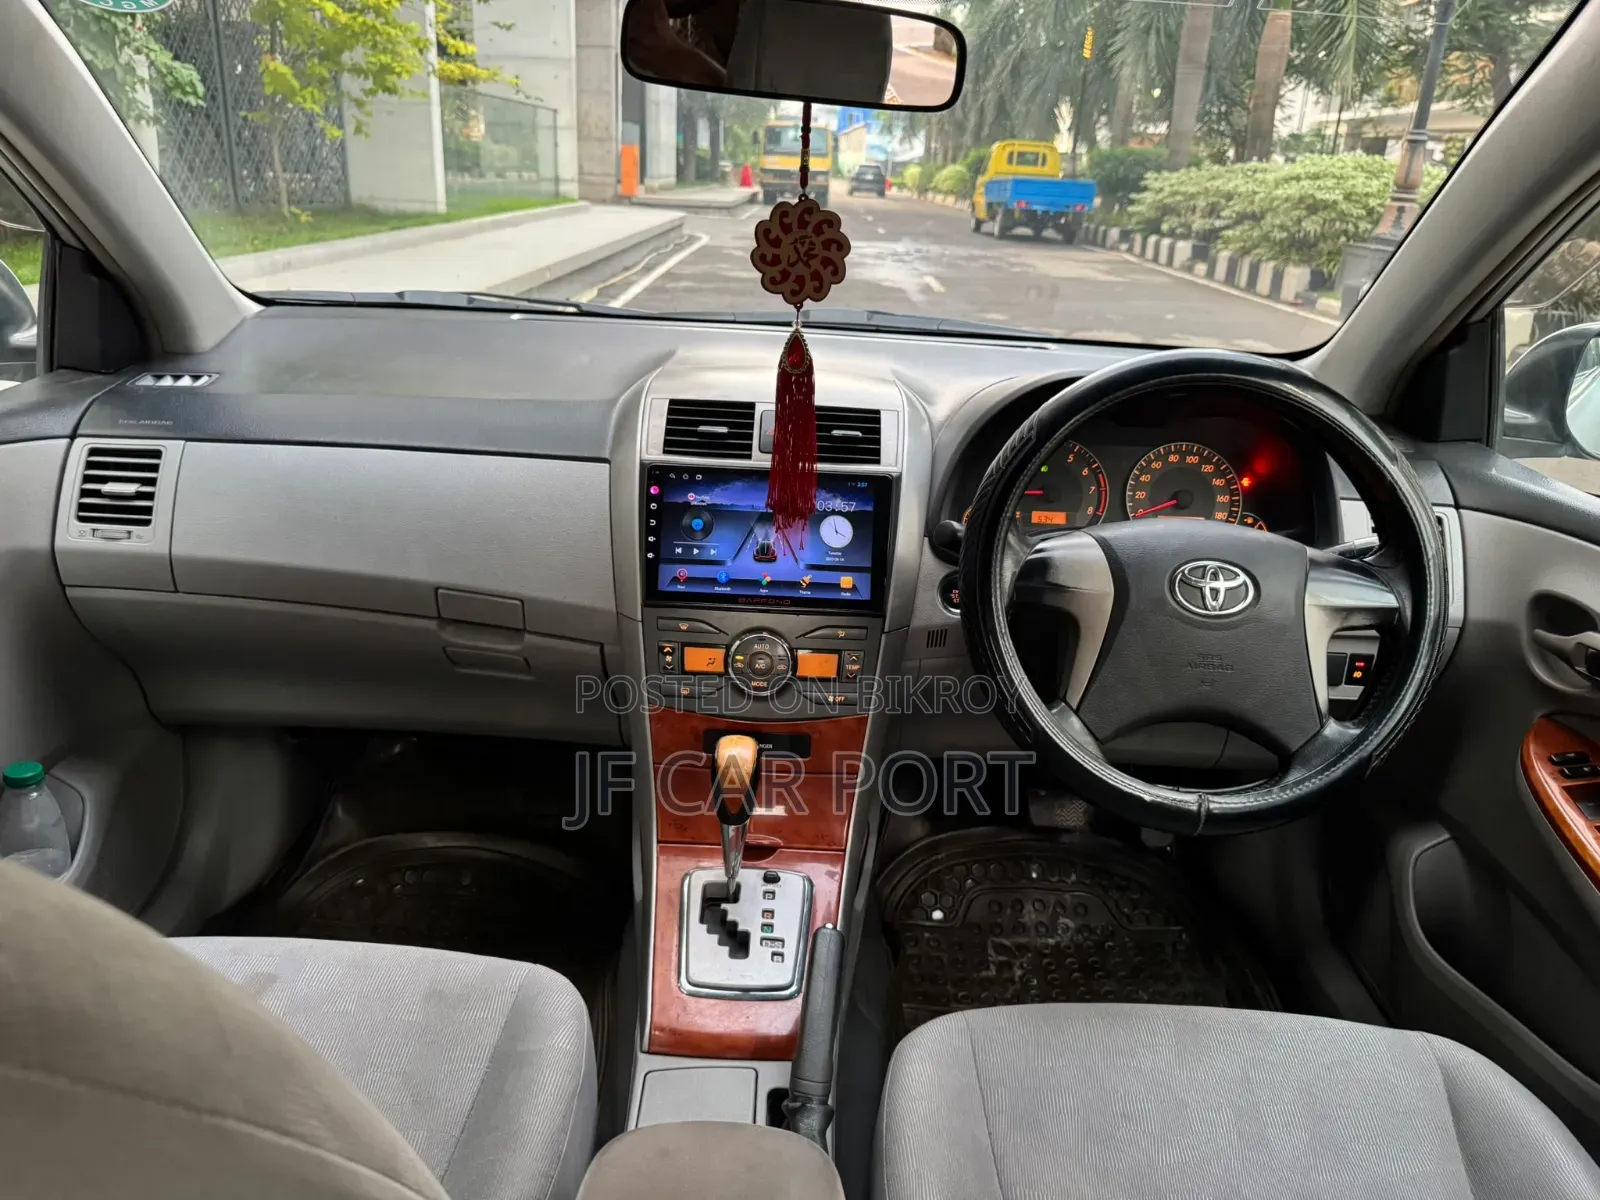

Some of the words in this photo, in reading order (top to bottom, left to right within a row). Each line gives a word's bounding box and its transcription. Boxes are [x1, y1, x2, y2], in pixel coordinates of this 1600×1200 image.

[1067, 454, 1074, 462] 5
[1082, 467, 1088, 476] 6
[1089, 486, 1096, 494] 7
[817, 500, 856, 512] 03:57
[1087, 506, 1094, 515] 8
[1186, 661, 1235, 671] AIRBAG
[764, 912, 772, 920] R
[763, 925, 772, 933] N
